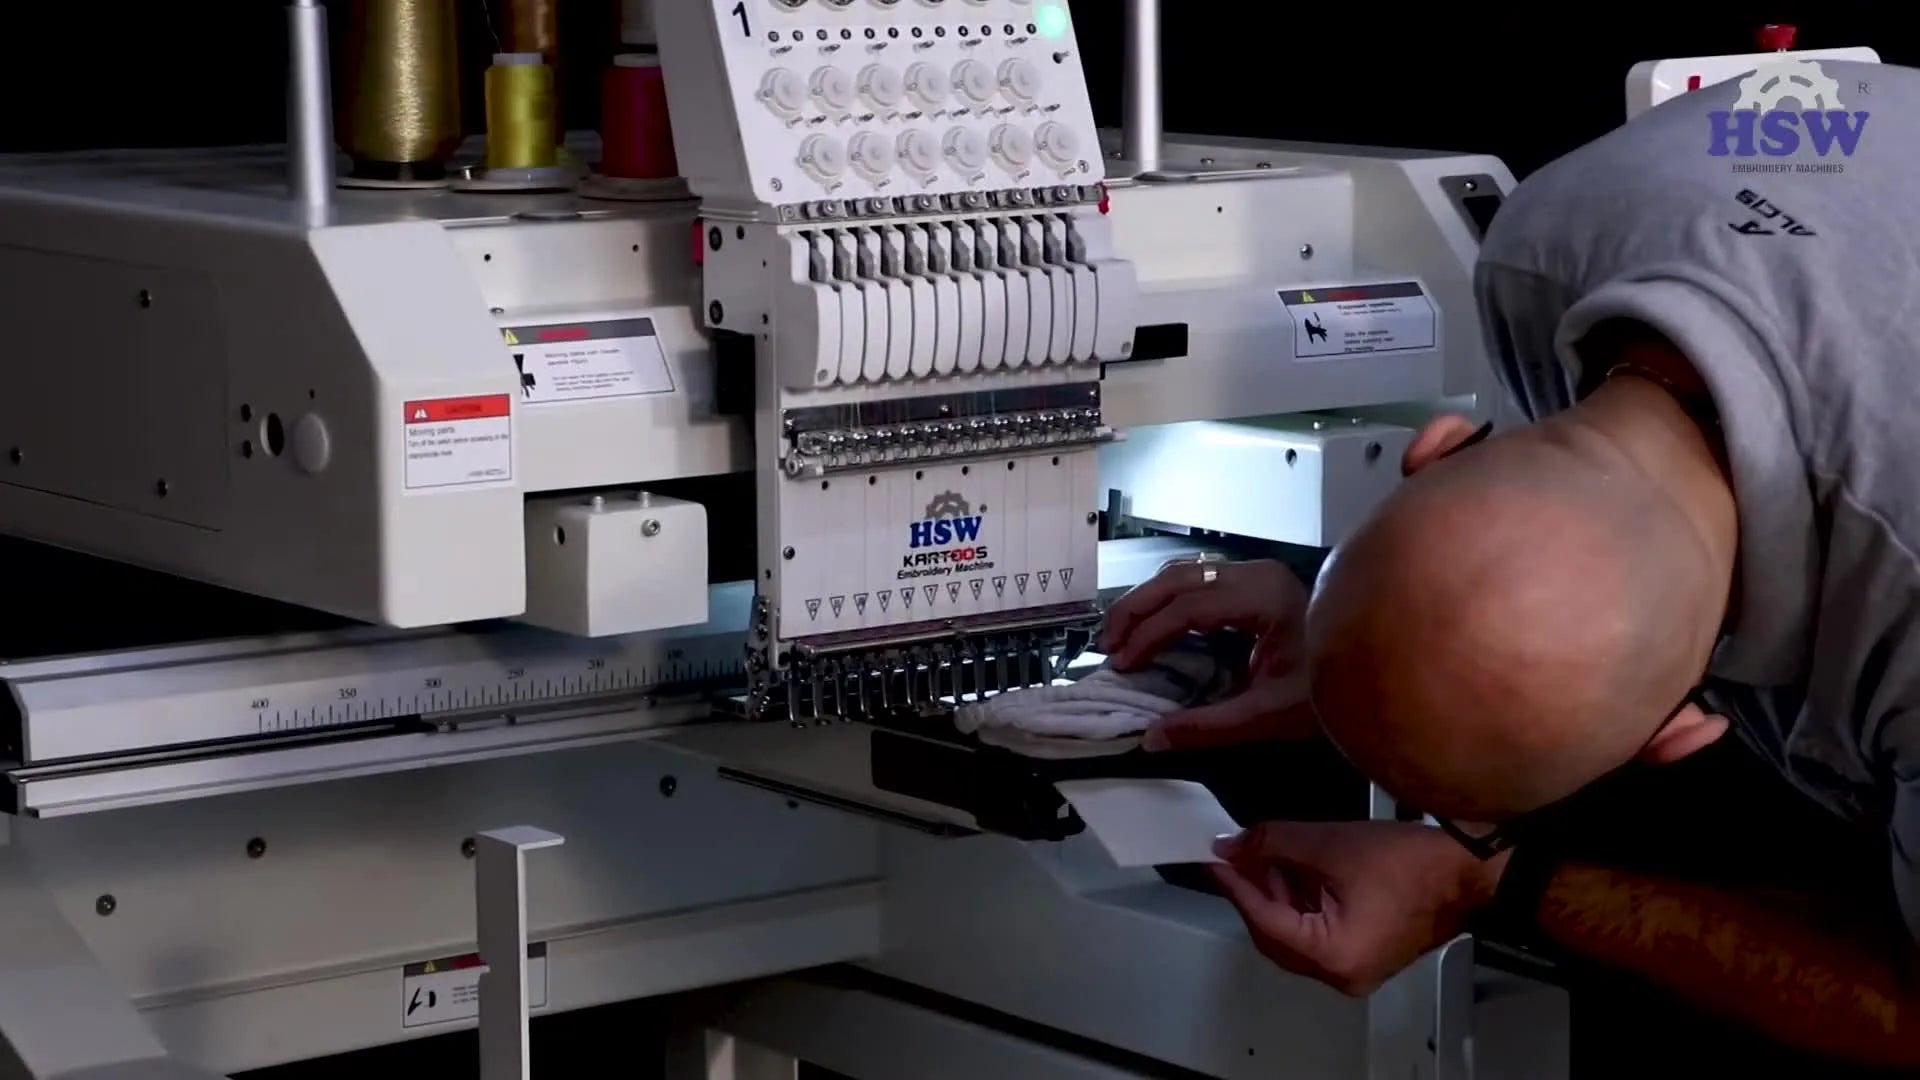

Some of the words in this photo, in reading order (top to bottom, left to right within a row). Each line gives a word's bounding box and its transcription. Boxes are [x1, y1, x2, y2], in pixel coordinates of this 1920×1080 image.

[732, 1, 750, 37] 1
[909, 516, 982, 548] HSW
[897, 567, 953, 580] Embroidery
[955, 561, 995, 573] Machine
[251, 699, 269, 709] 400
[338, 688, 358, 698] 350
